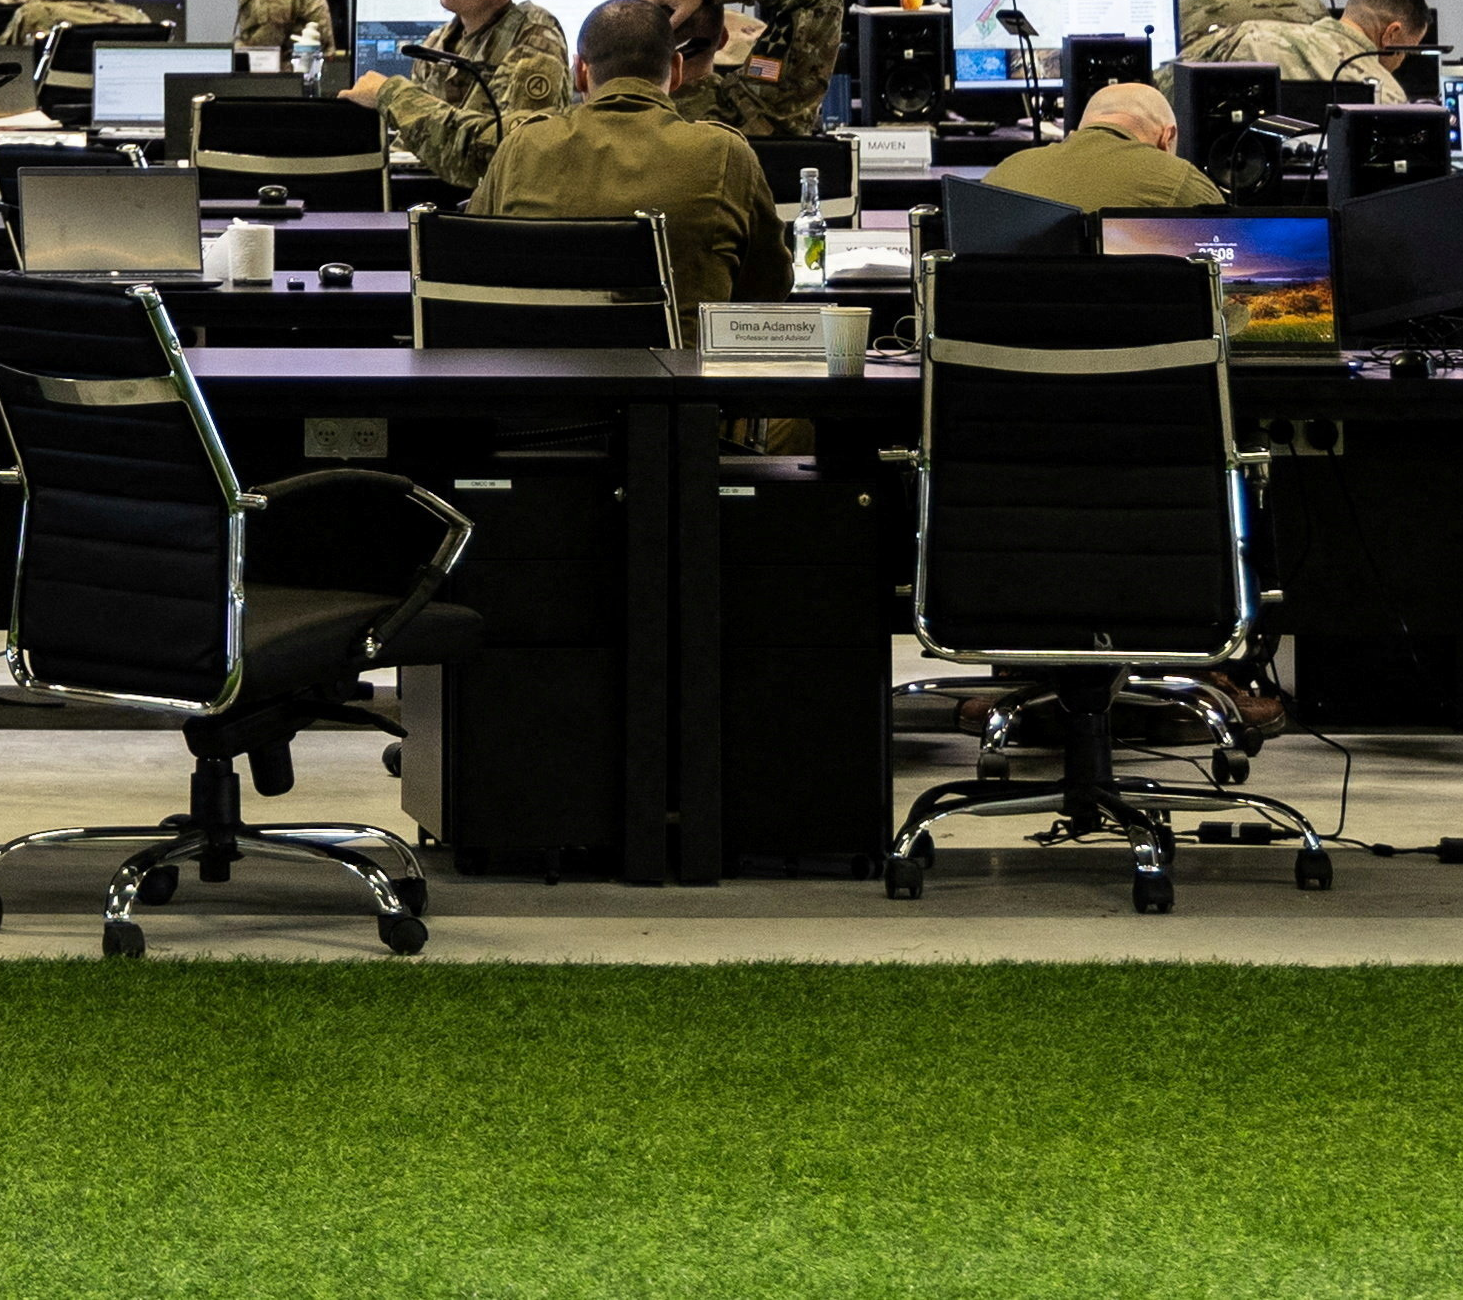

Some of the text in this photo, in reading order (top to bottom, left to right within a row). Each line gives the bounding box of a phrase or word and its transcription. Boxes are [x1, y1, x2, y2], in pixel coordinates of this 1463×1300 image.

[867, 141, 906, 150] MAVEN
[729, 320, 817, 334] Dima Adamsky
